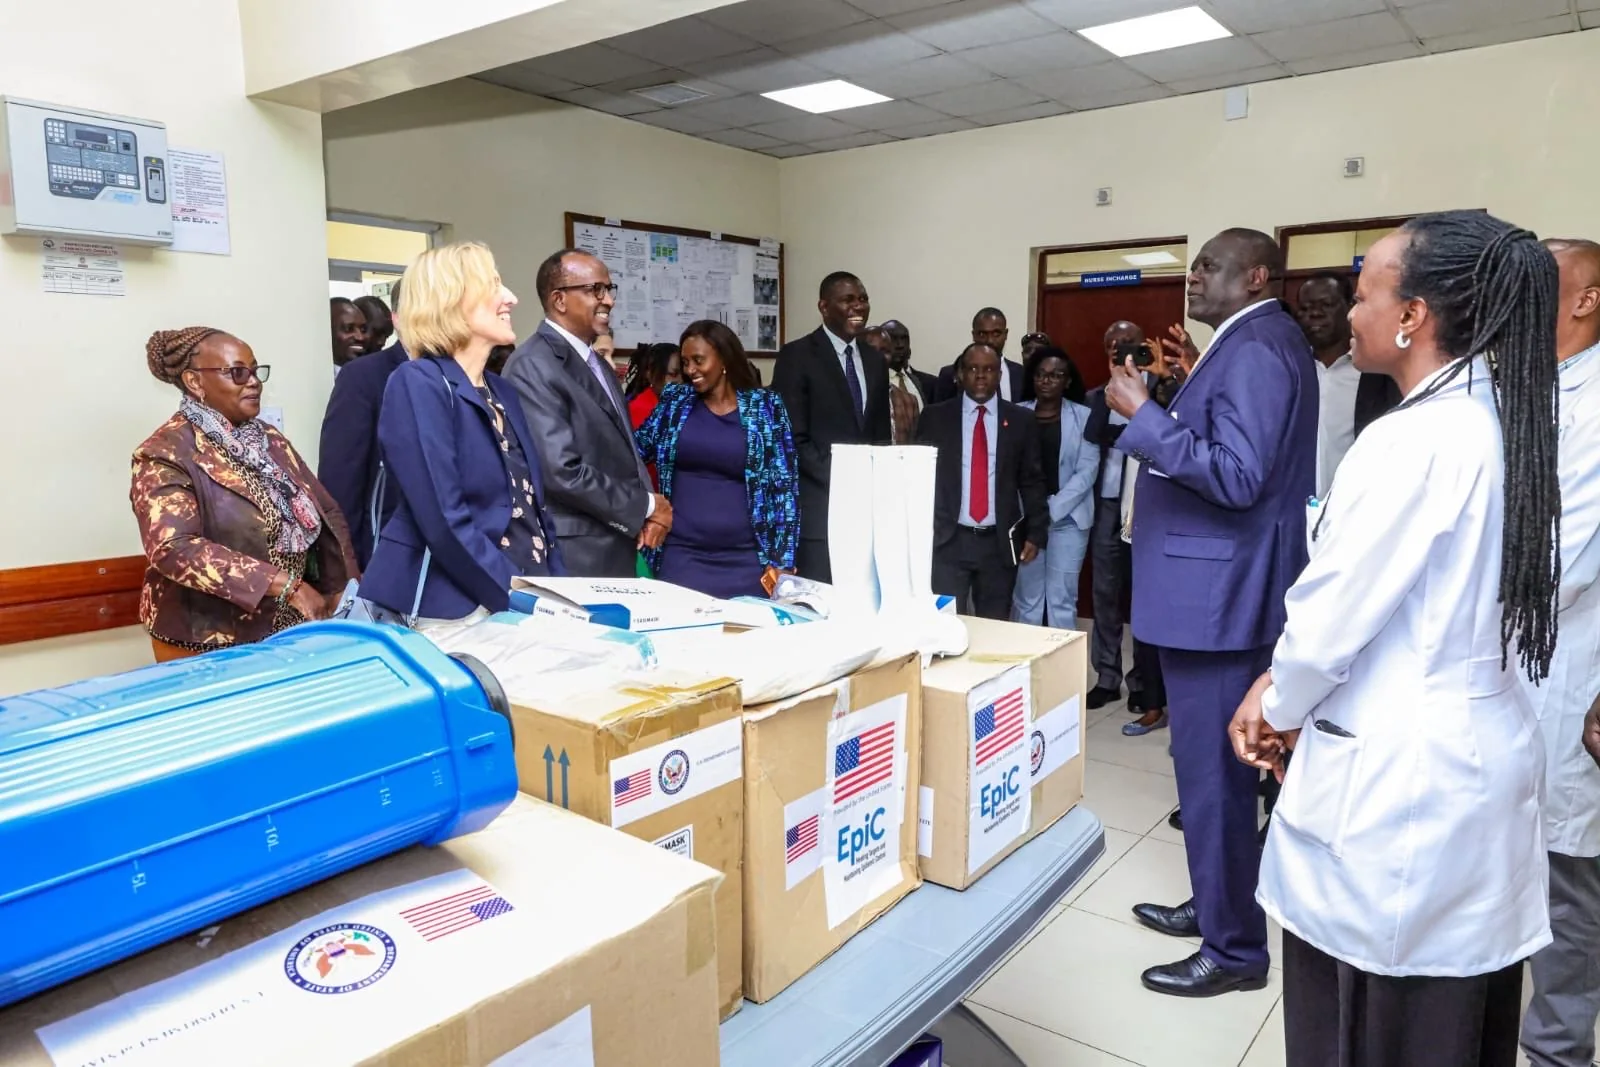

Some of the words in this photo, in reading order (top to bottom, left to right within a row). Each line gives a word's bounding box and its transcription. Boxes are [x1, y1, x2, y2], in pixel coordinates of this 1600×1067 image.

[980, 765, 1020, 820] EpiC
[264, 826, 280, 852] 10L
[837, 807, 886, 866] EpiC
[131, 872, 146, 893] 5L
[313, 924, 349, 937] STATES
[352, 924, 386, 938] UNITED
[300, 937, 311, 946] OF
[356, 946, 395, 990] DEPARTMENT
[304, 983, 334, 994] STATE
[339, 985, 352, 993] OF
